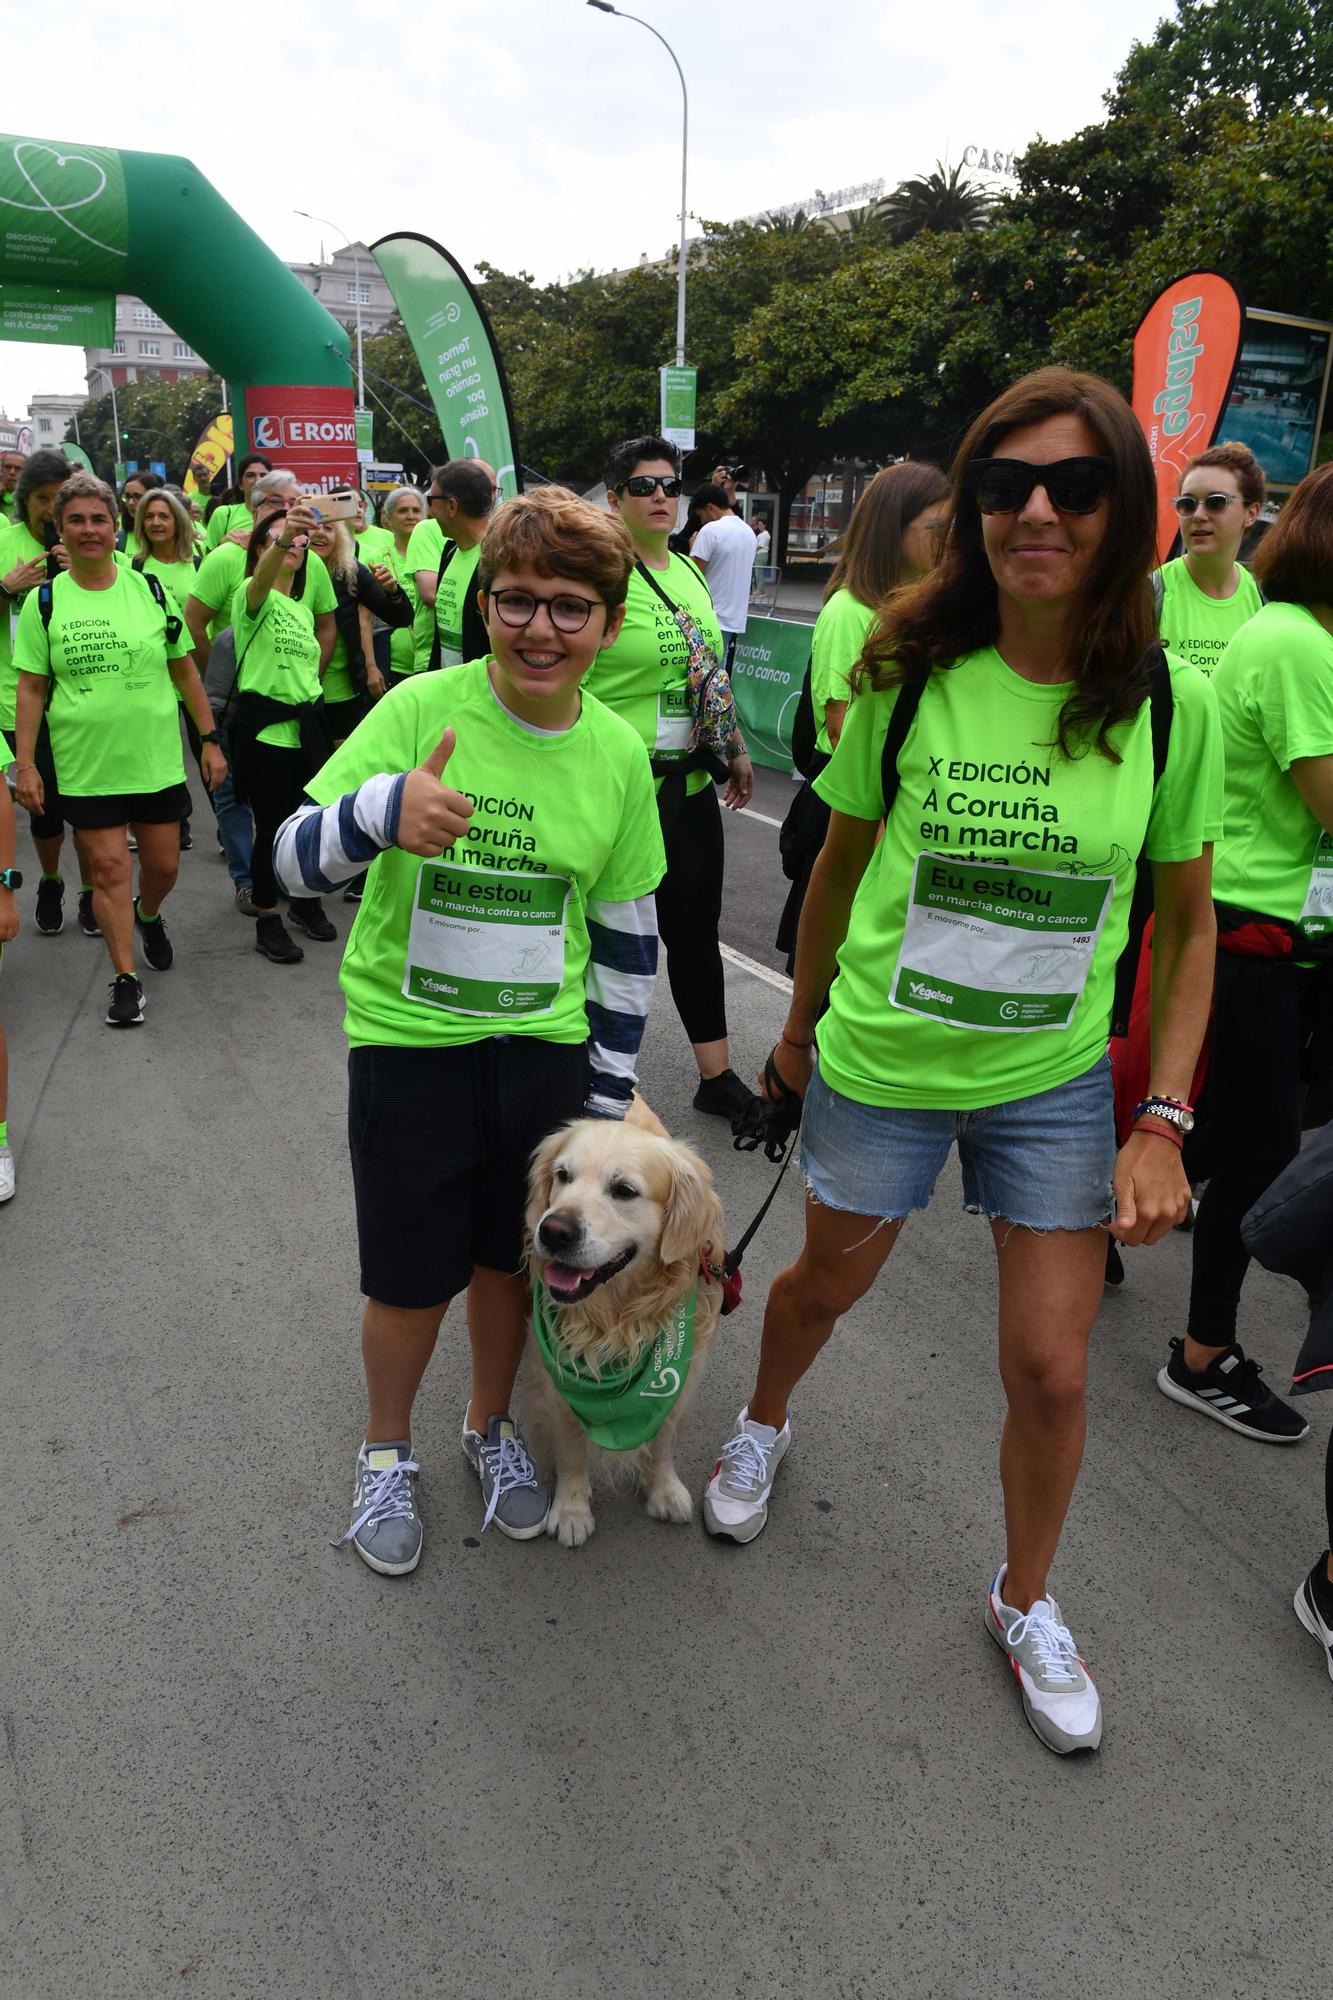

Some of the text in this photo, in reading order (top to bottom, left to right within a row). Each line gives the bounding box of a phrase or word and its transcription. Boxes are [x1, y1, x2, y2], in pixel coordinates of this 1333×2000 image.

[4, 311, 33, 319] contra
[289, 422, 355, 442] EROSKI
[61, 618, 110, 631] X EDICIÓN
[655, 617, 664, 627] A
[62, 630, 117, 644] A Coruña
[658, 630, 673, 640] en
[64, 640, 128, 655] en marcha
[275, 636, 303, 649] contra
[660, 640, 689, 653] cont
[1179, 638, 1228, 650] X EDICIÓN
[66, 653, 105, 666] contra
[284, 647, 309, 660] cancro
[1190, 654, 1219, 666] Coru
[660, 657, 668, 666] o
[79, 664, 120, 676] cancro
[747, 664, 754, 676] o
[755, 666, 790, 684] cancro
[667, 694, 682, 706] Eu
[928, 756, 1051, 787] X EDICIÓN
[456, 790, 535, 822] DICIÓN
[922, 788, 1059, 823] A Coruña
[458, 827, 536, 852] oruña
[920, 821, 1078, 854] en marcha
[462, 848, 548, 873] marcha
[433, 872, 532, 904] Eu estou
[931, 867, 1053, 906] Eu estou
[430, 898, 443, 907] en
[445, 901, 485, 915] marcha
[487, 908, 519, 918] contra
[530, 910, 556, 919] cancro
[928, 893, 1088, 925] en marcha contra o cancro
[927, 912, 933, 920] E
[548, 929, 560, 937] 1494
[1072, 936, 1091, 944] 1493
[420, 977, 459, 996] Vegalsa
[909, 981, 954, 1004] Vegalsa
[679, 1321, 685, 1329] o
